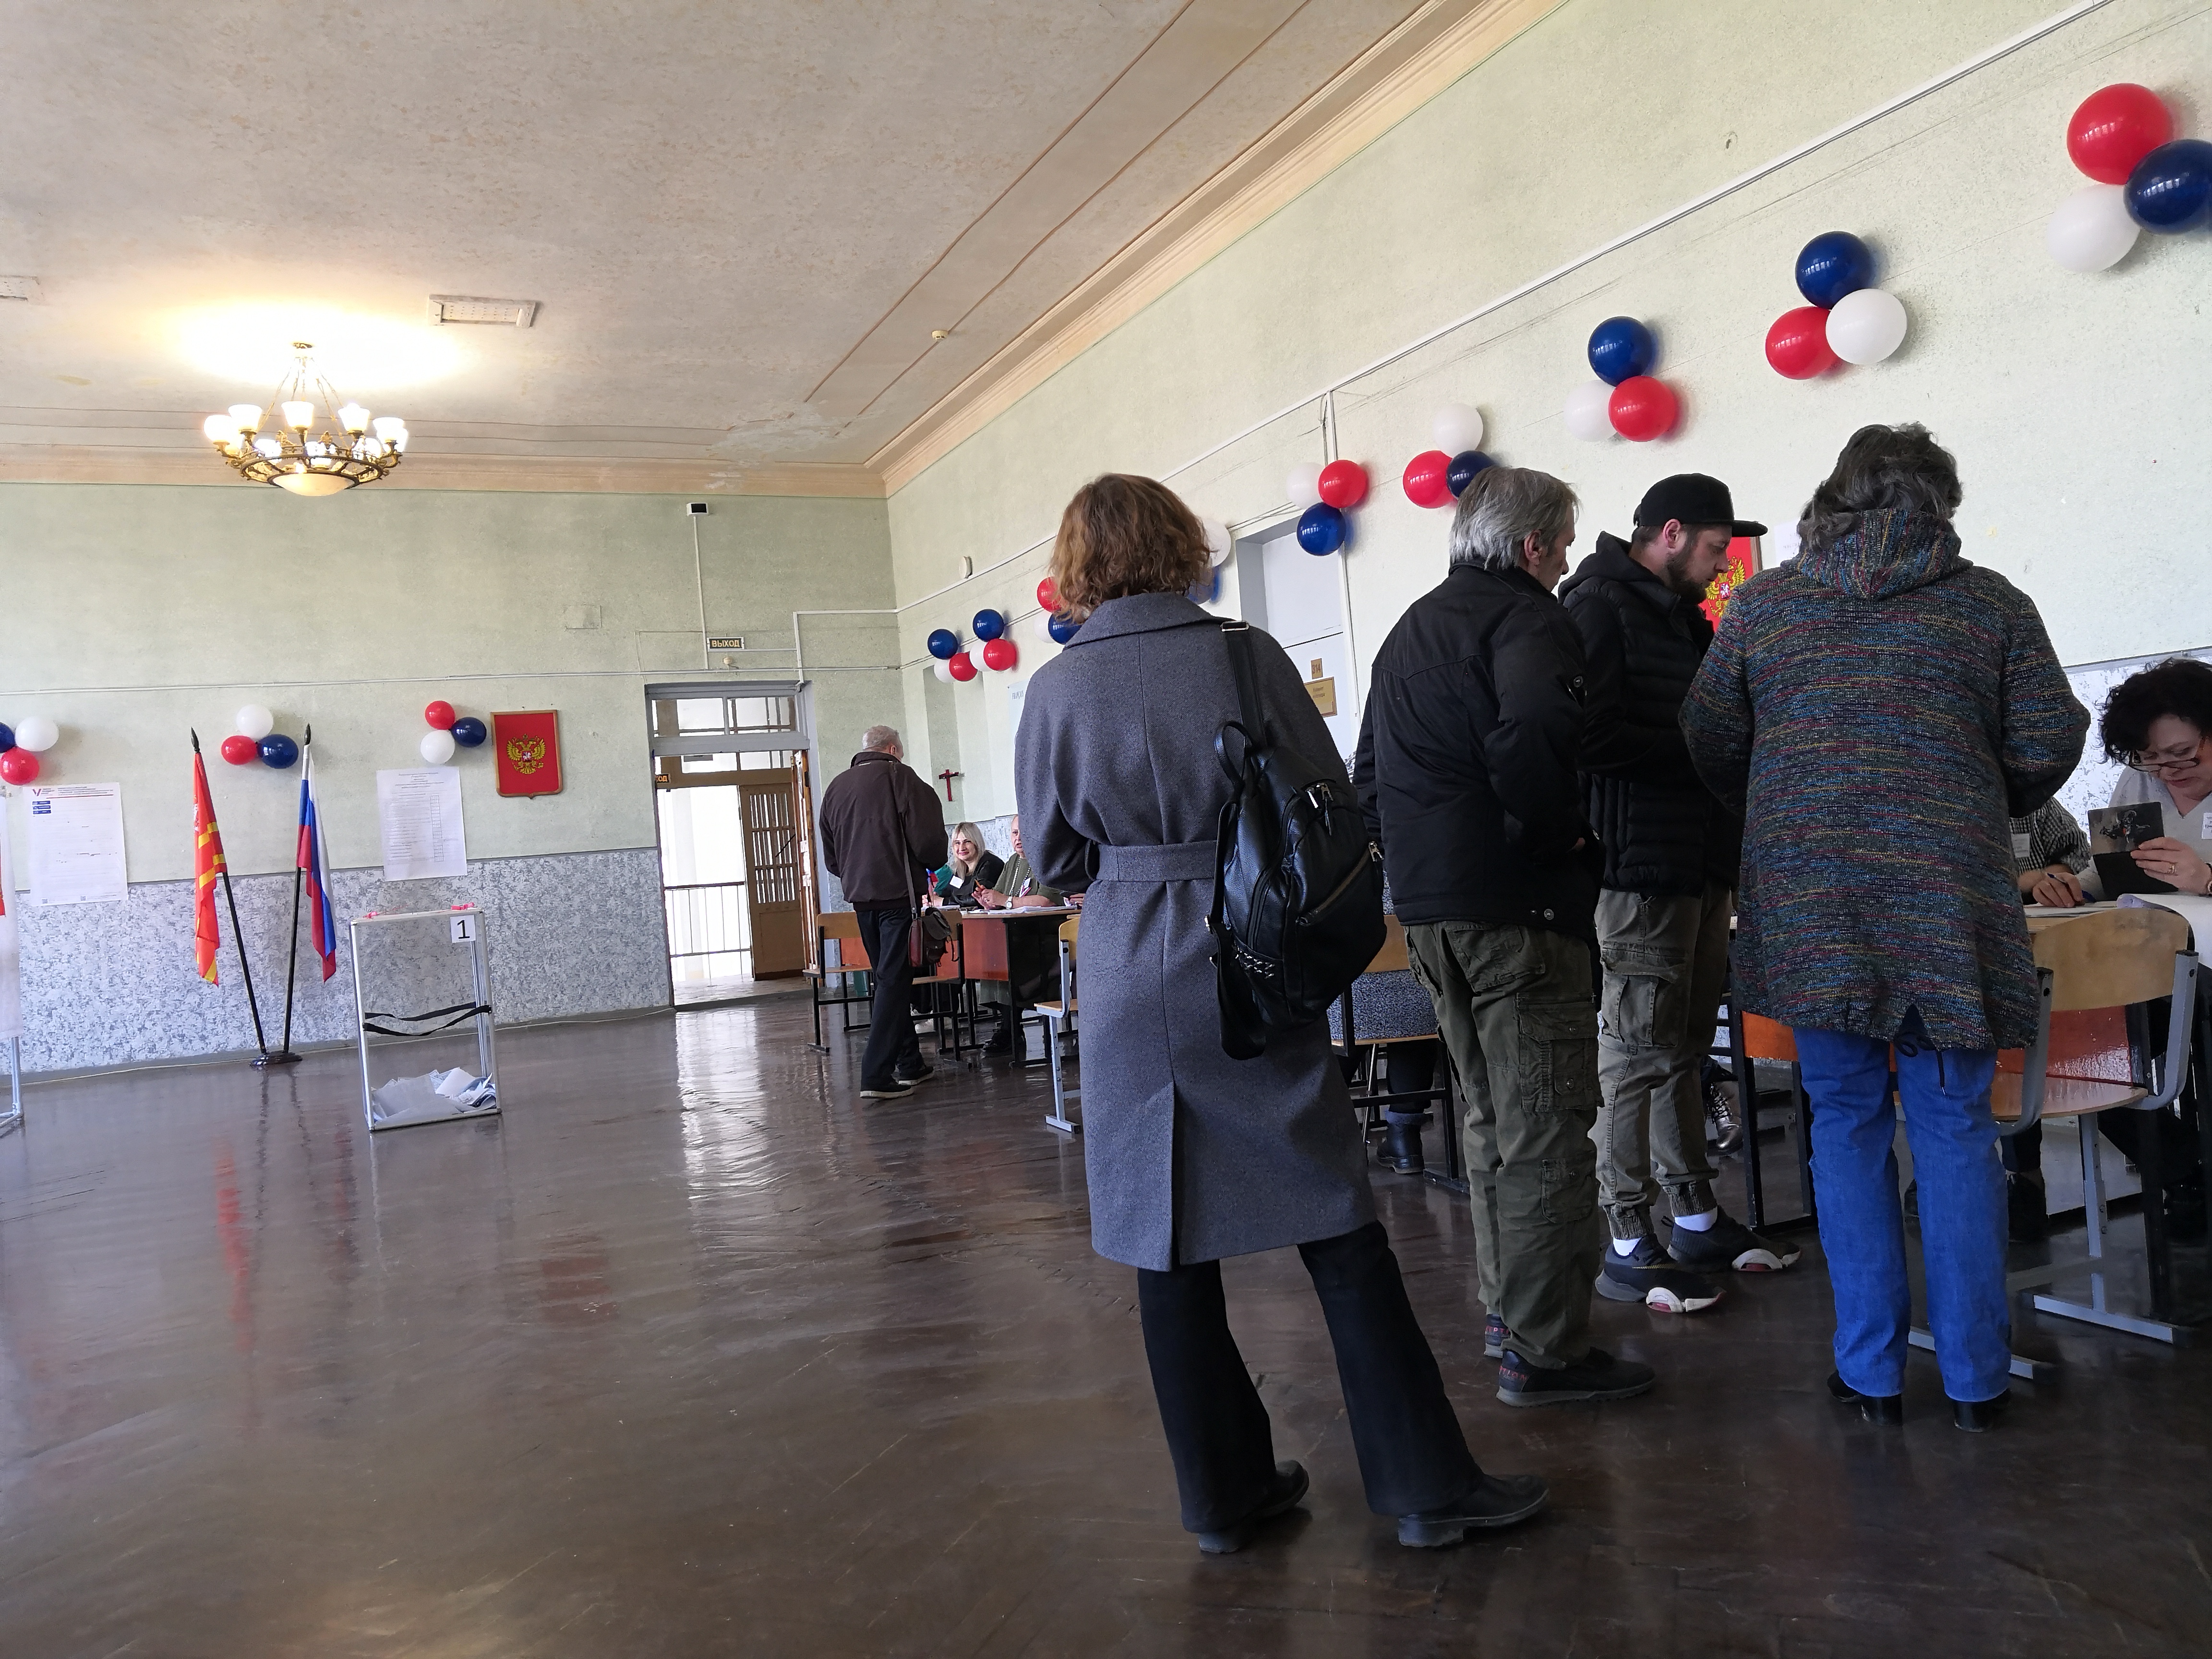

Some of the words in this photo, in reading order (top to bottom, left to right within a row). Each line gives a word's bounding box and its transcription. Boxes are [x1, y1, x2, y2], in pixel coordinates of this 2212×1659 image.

[711, 639, 740, 648] ВЫХОД
[1311, 663, 1321, 674] 314
[457, 920, 470, 939] 1
